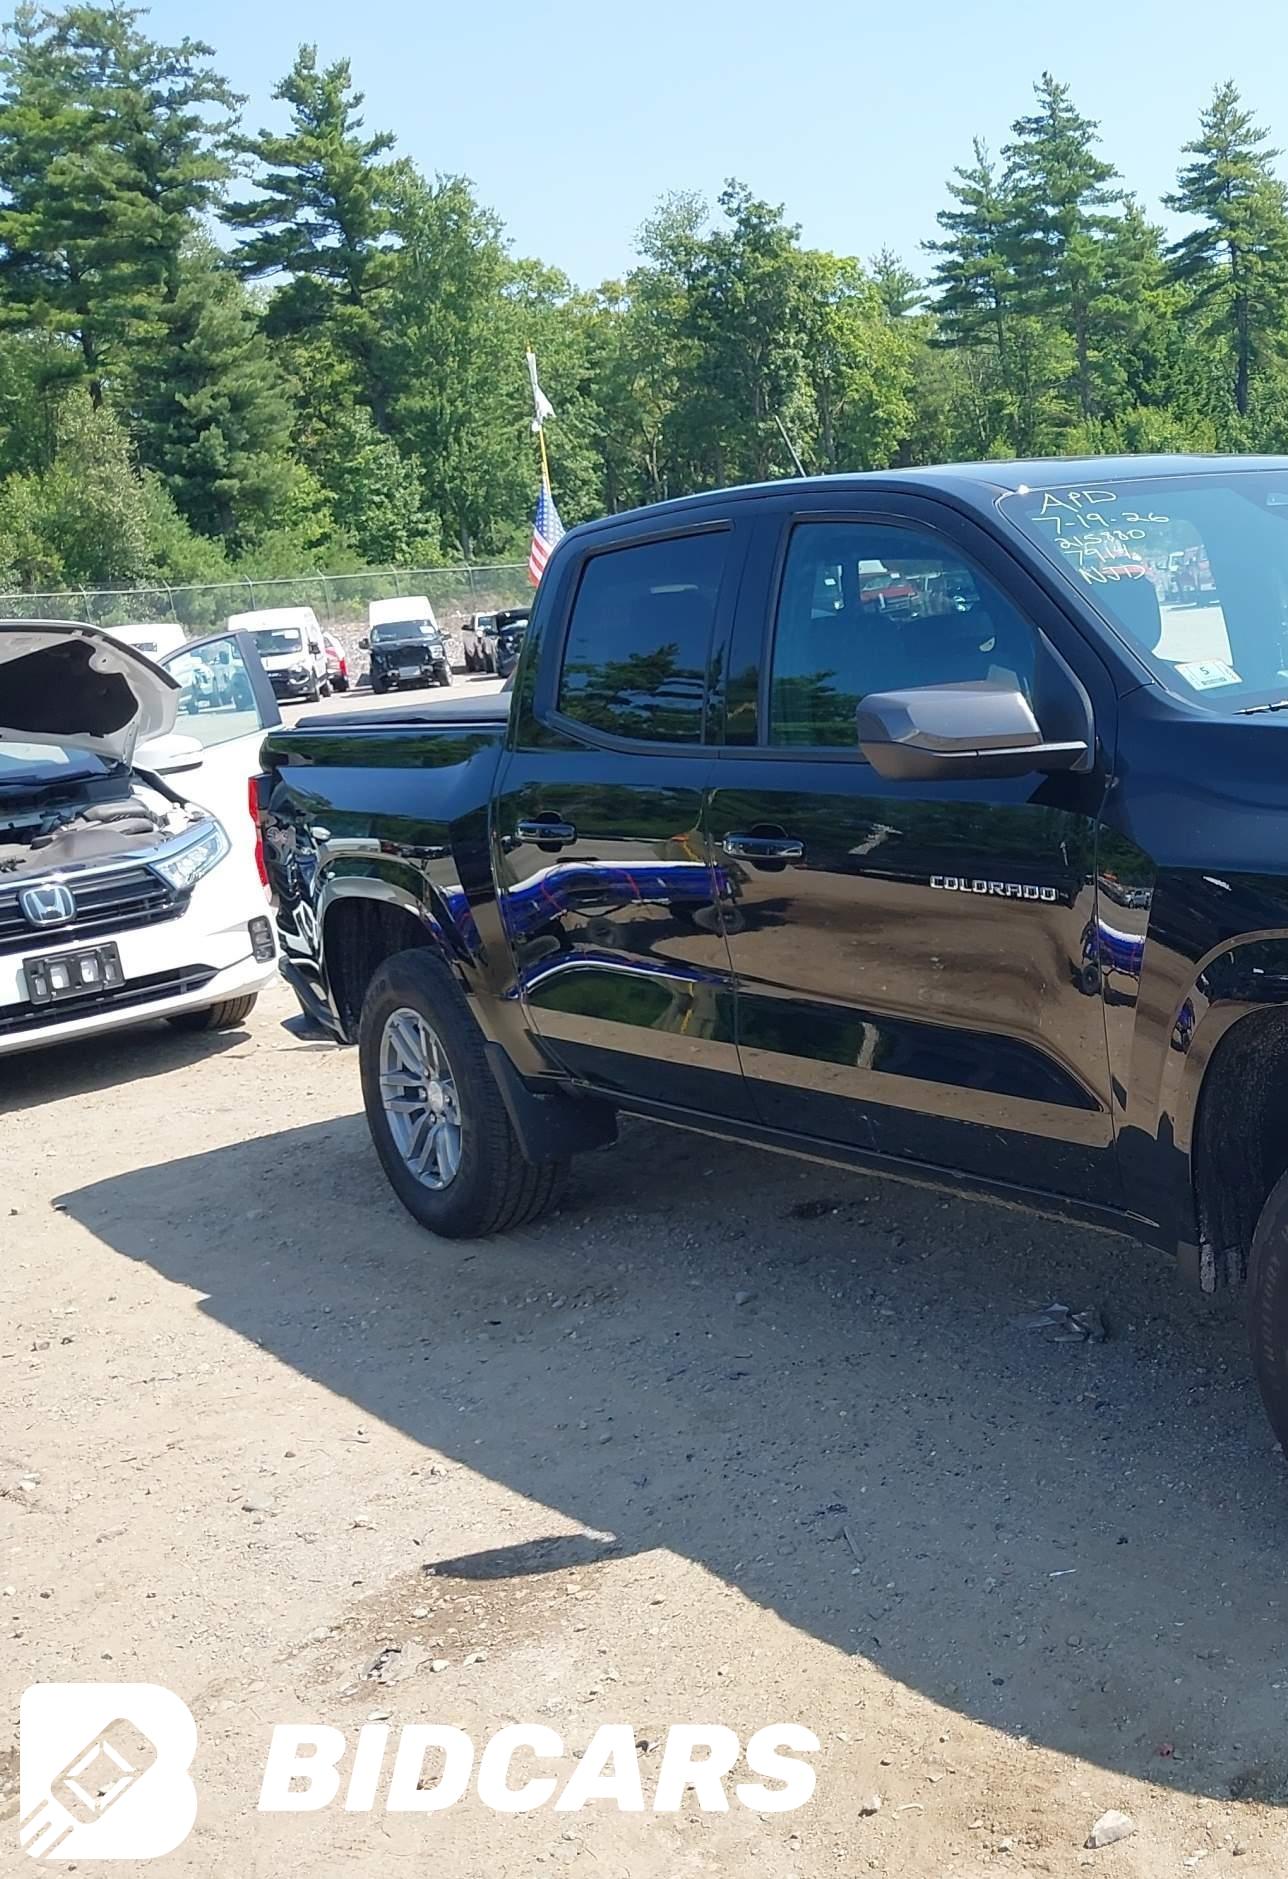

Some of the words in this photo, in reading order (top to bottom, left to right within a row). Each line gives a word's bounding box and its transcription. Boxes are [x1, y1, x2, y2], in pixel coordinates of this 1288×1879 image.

[1041, 490, 1116, 514] APD
[1032, 513, 1169, 534] 7-19-26
[930, 875, 1056, 900] COLORADO
